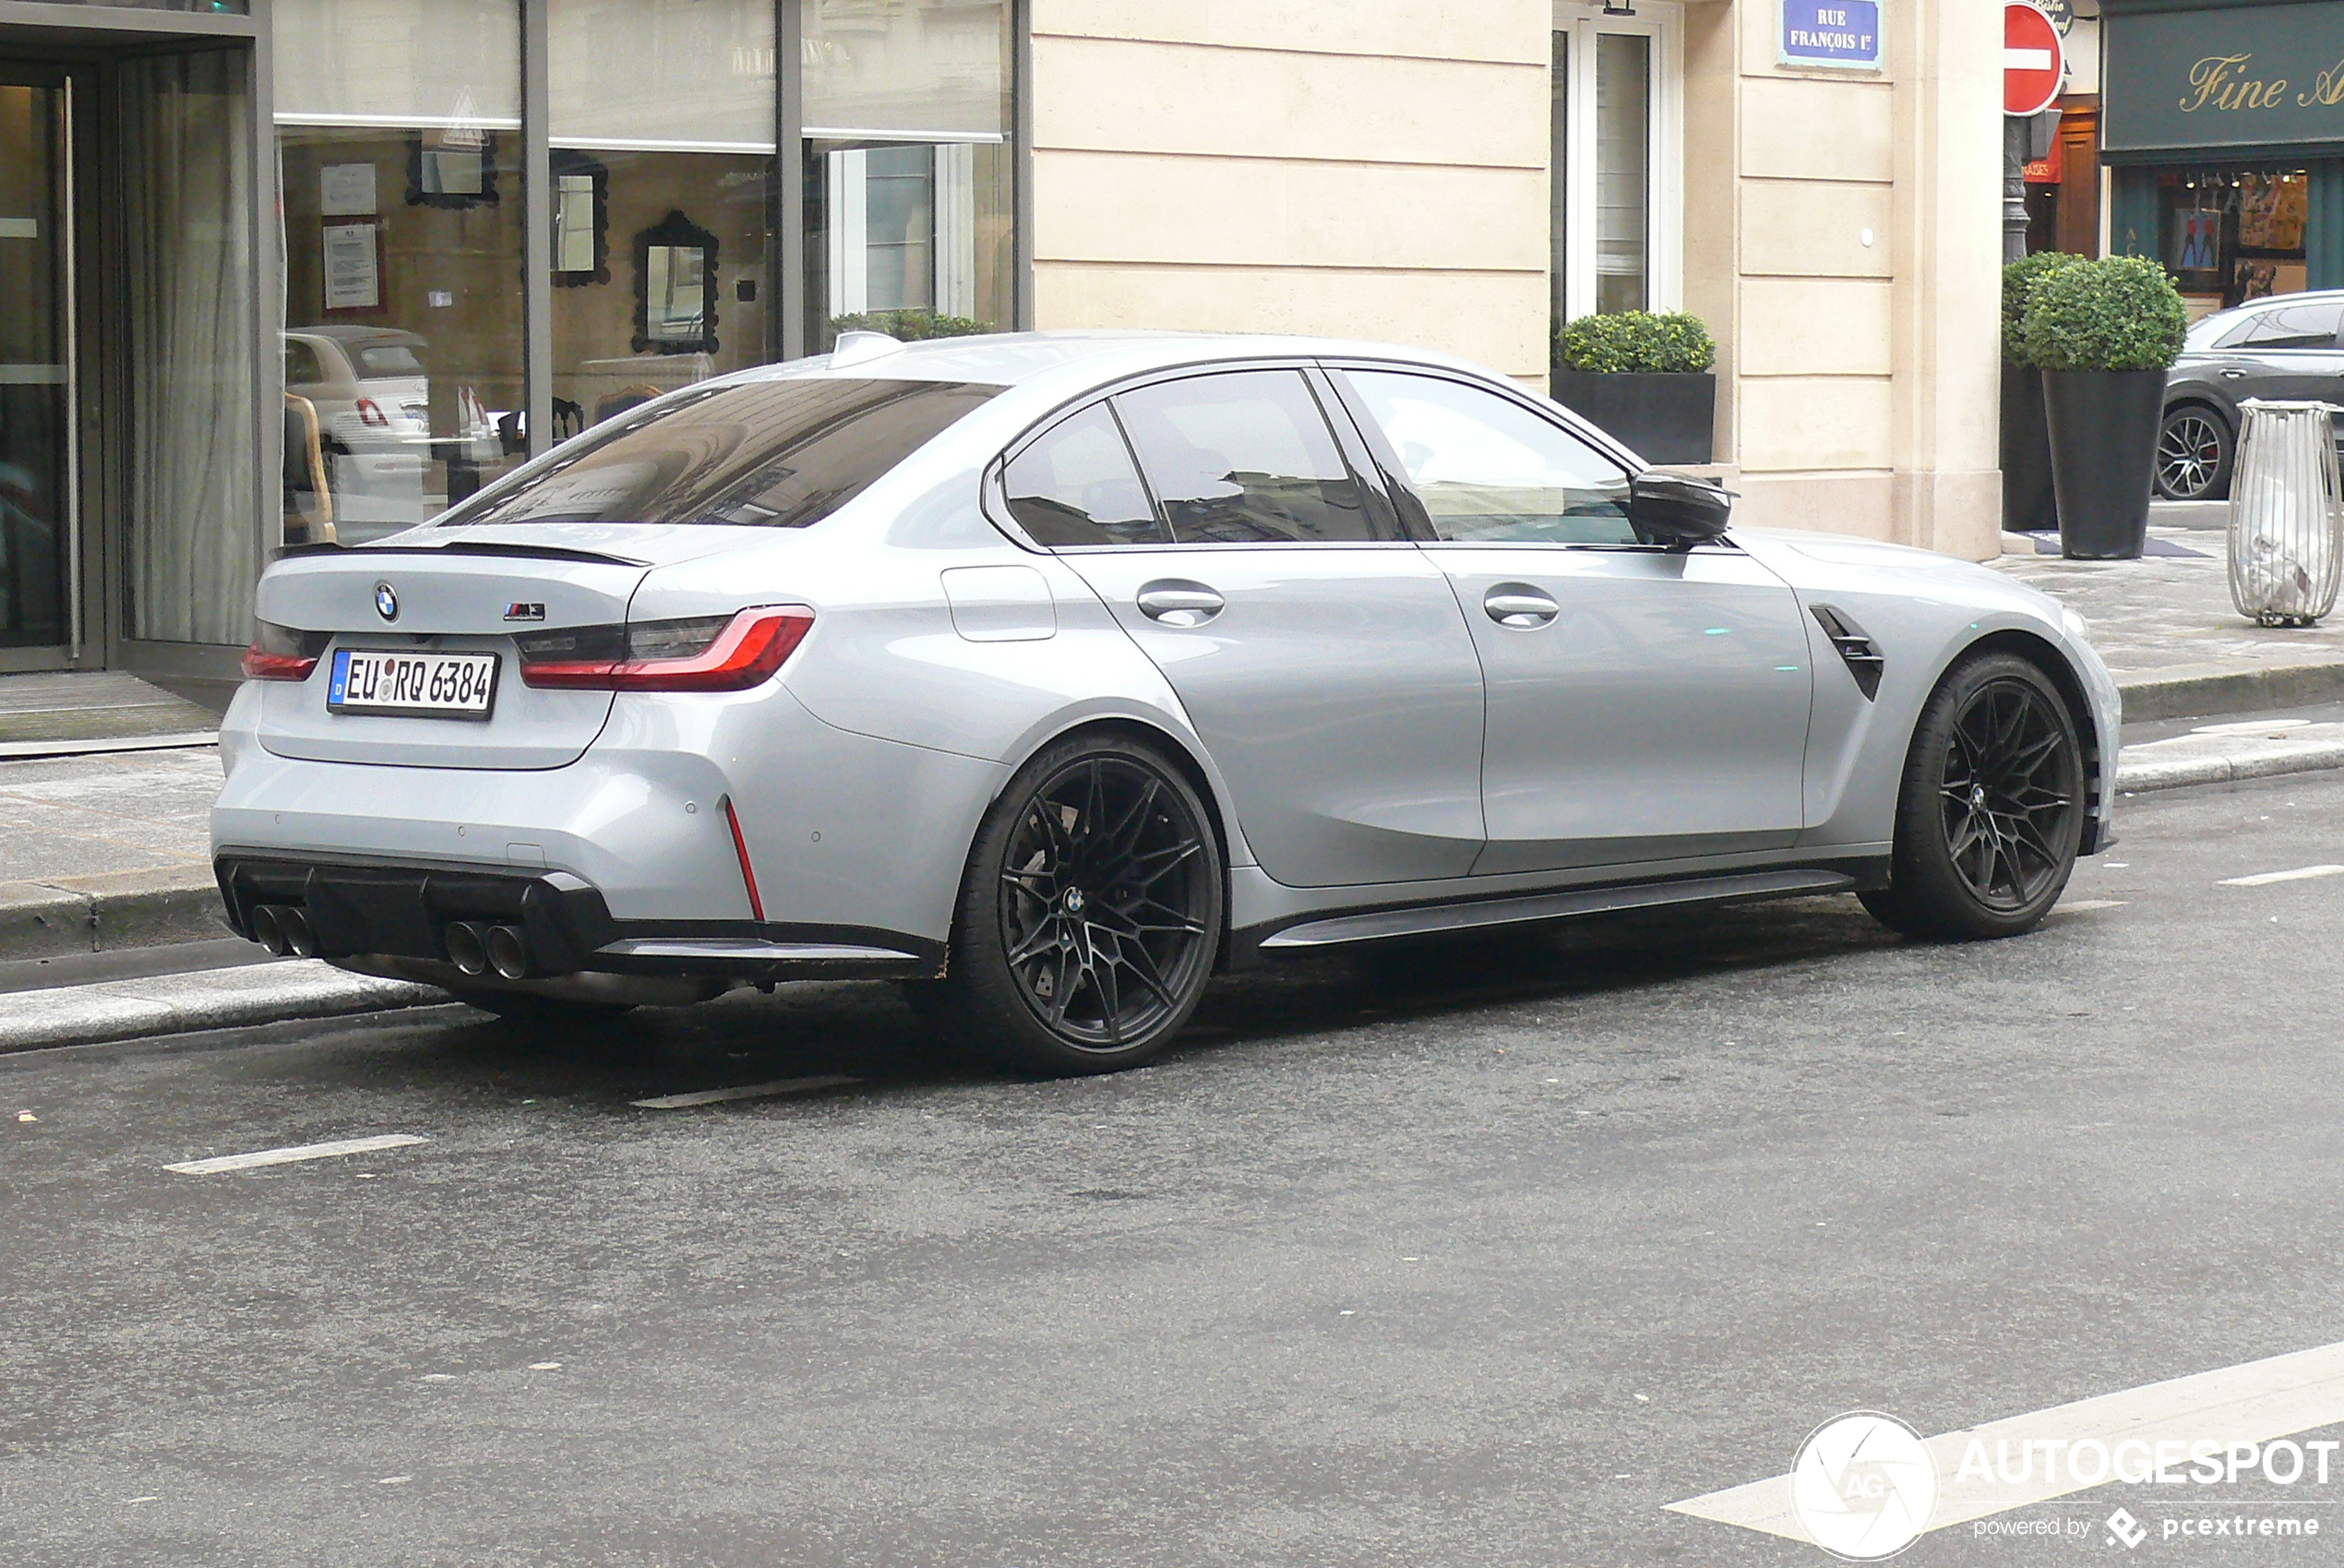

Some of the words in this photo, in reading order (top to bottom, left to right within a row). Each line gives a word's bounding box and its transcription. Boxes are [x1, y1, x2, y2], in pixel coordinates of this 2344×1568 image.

[1817, 9, 1847, 26] RUE
[1790, 30, 1856, 53] FRANÇOIS
[2179, 53, 2288, 113] Fine
[335, 683, 342, 696] D
[347, 659, 379, 700] EU
[393, 661, 426, 701] RQ
[430, 661, 487, 704] 6384
